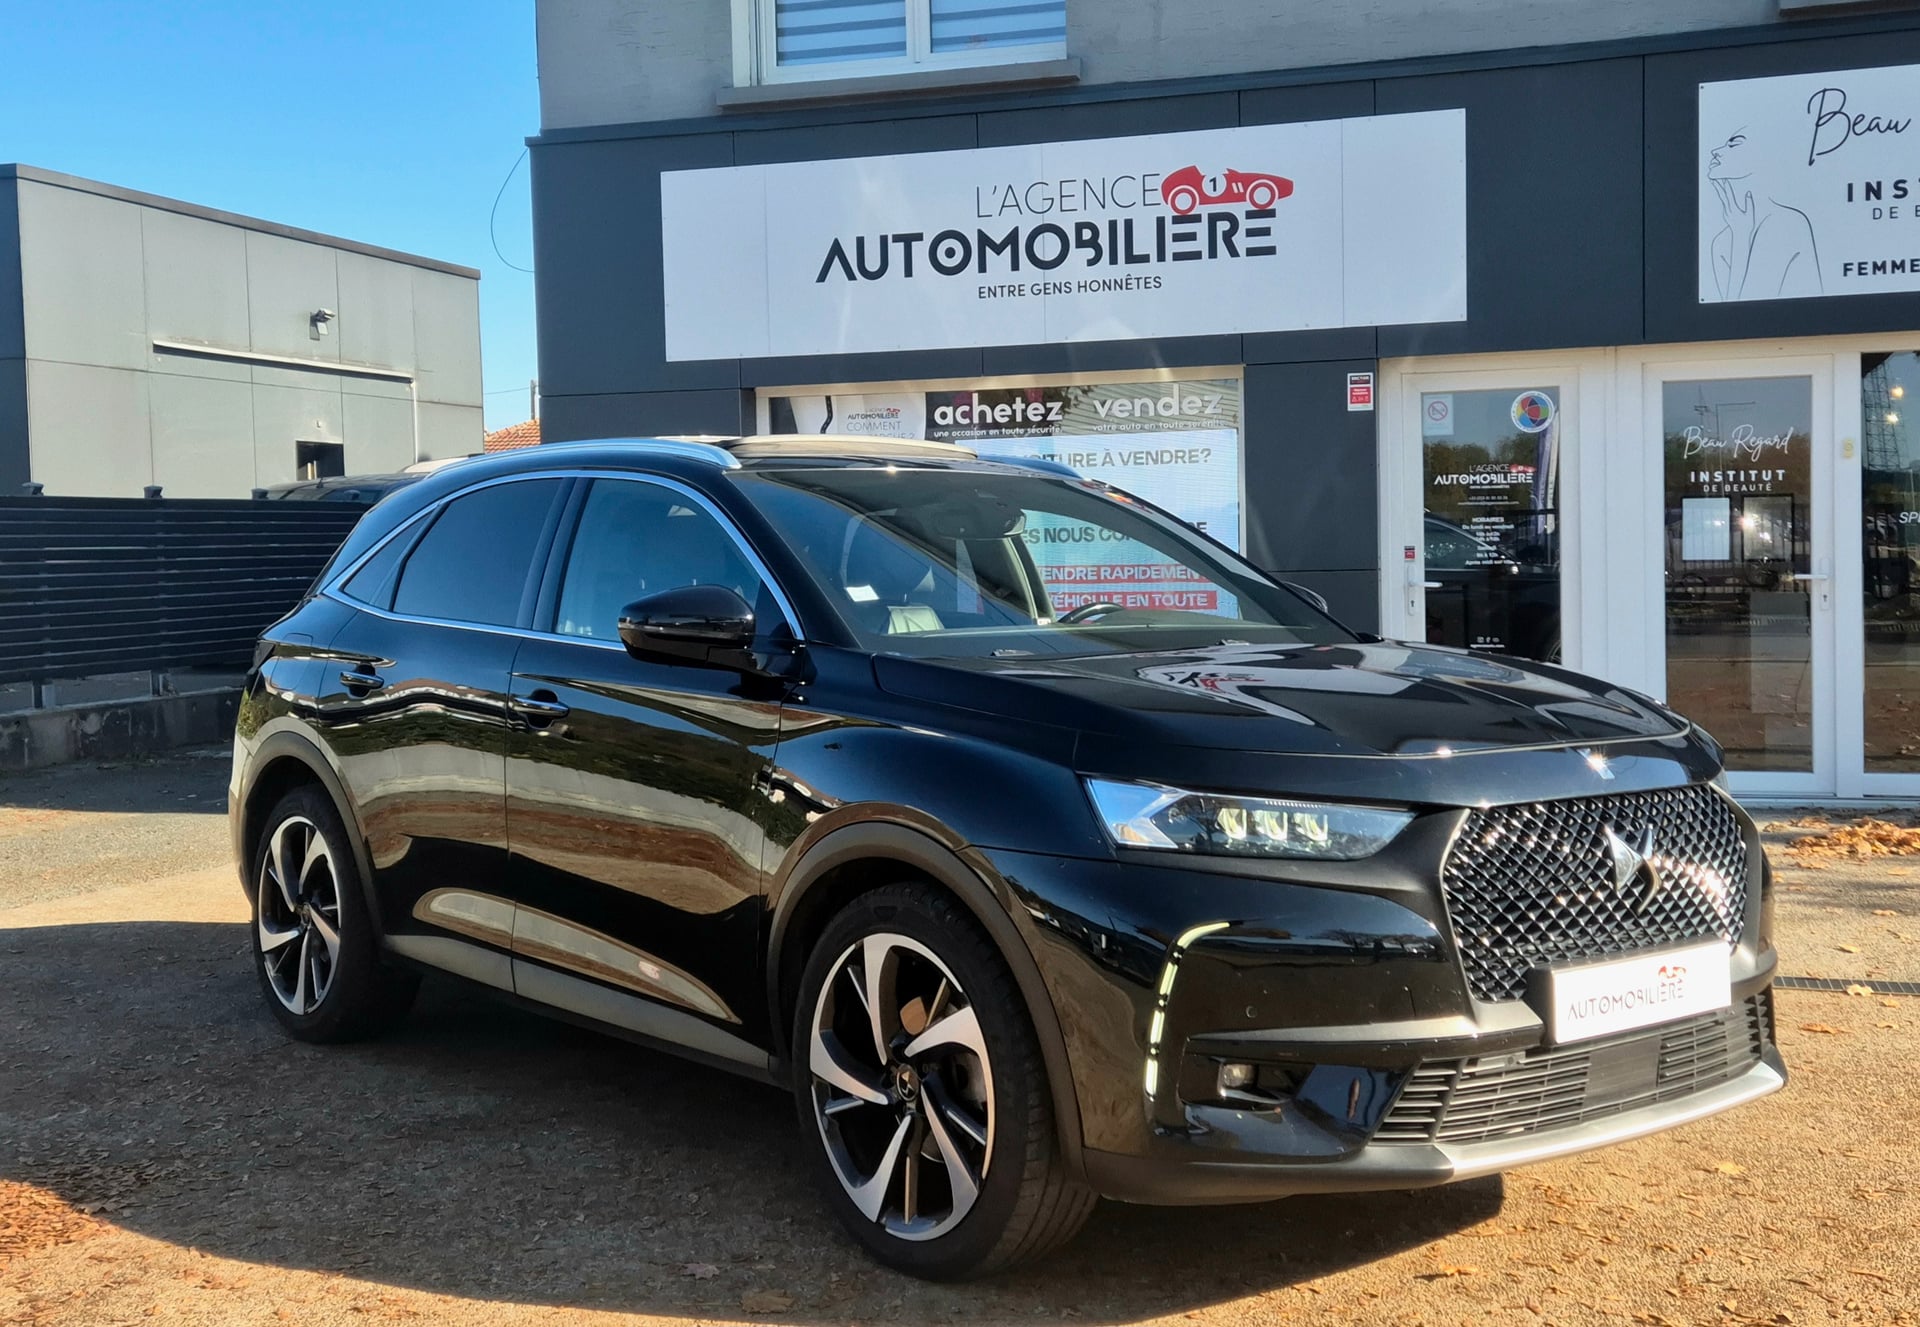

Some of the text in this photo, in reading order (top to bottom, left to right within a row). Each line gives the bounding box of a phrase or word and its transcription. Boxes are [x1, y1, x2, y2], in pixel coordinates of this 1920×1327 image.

[1807, 88, 1912, 166] Beau
[1846, 178, 1920, 203] INS
[1872, 205, 1899, 220] DE
[978, 273, 1162, 299] ENTRE GENS HONNÊTES
[1093, 383, 1223, 418] vendez
[933, 392, 1063, 426] achetez
[846, 420, 902, 432] COMMENT
[951, 427, 987, 438] occasion
[1002, 427, 1025, 435] toute
[1092, 422, 1117, 432] votre
[1119, 422, 1142, 431] auto
[1159, 420, 1185, 430] toute
[1683, 423, 1794, 462] Beau Regard
[1116, 448, 1212, 466] VENDRE?
[1690, 469, 1786, 483] INSTITUT
[1724, 482, 1772, 492] BEAUTÉ
[1899, 511, 1920, 524] SP
[1044, 526, 1095, 543] NOUS
[1100, 565, 1206, 580] RAPIDEMEN
[1126, 594, 1149, 607] EN
[1152, 593, 1208, 607] TOUTE
